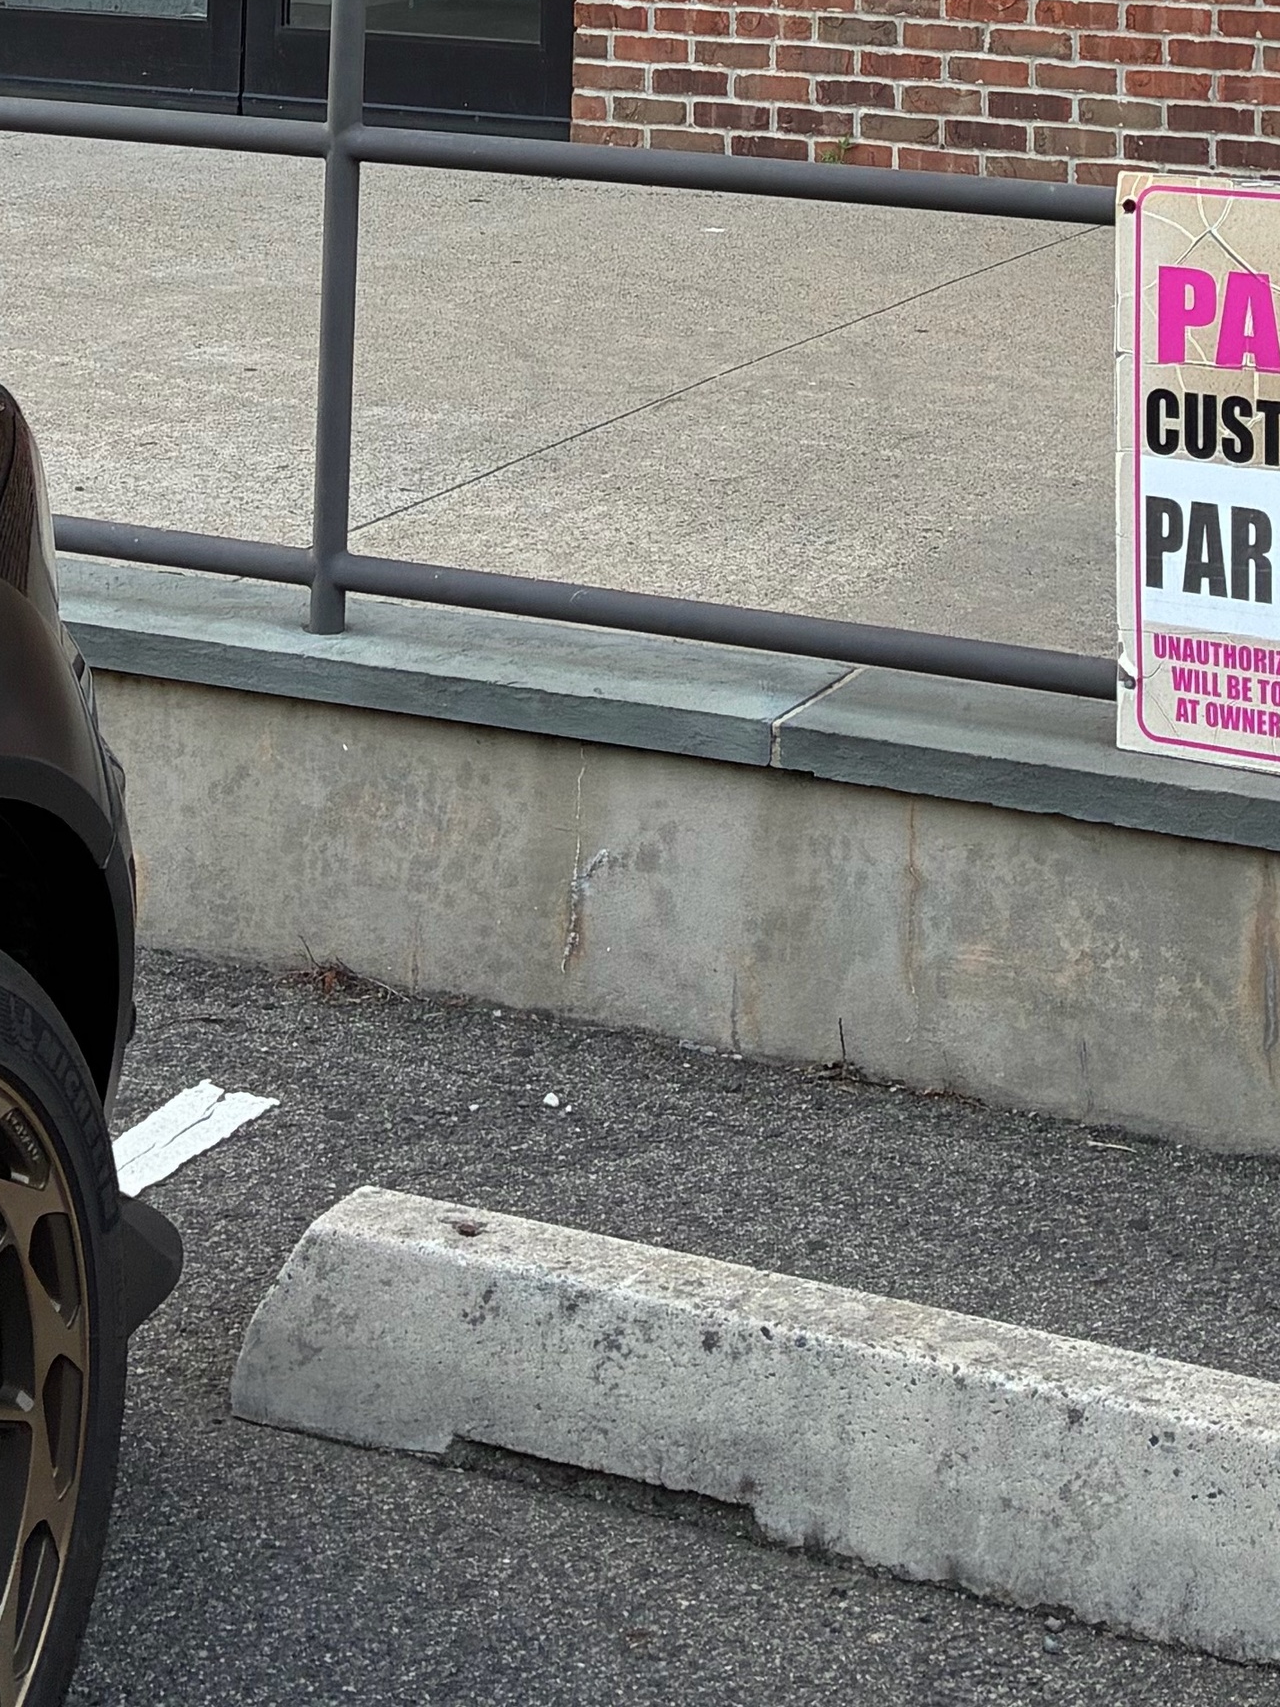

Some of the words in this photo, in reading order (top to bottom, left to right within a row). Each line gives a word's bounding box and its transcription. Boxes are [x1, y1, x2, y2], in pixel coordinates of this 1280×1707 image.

[1145, 495, 1273, 605] PAR
[1171, 665, 1222, 698] WILL
[1226, 674, 1253, 703] BE
[1175, 697, 1201, 725] AT
